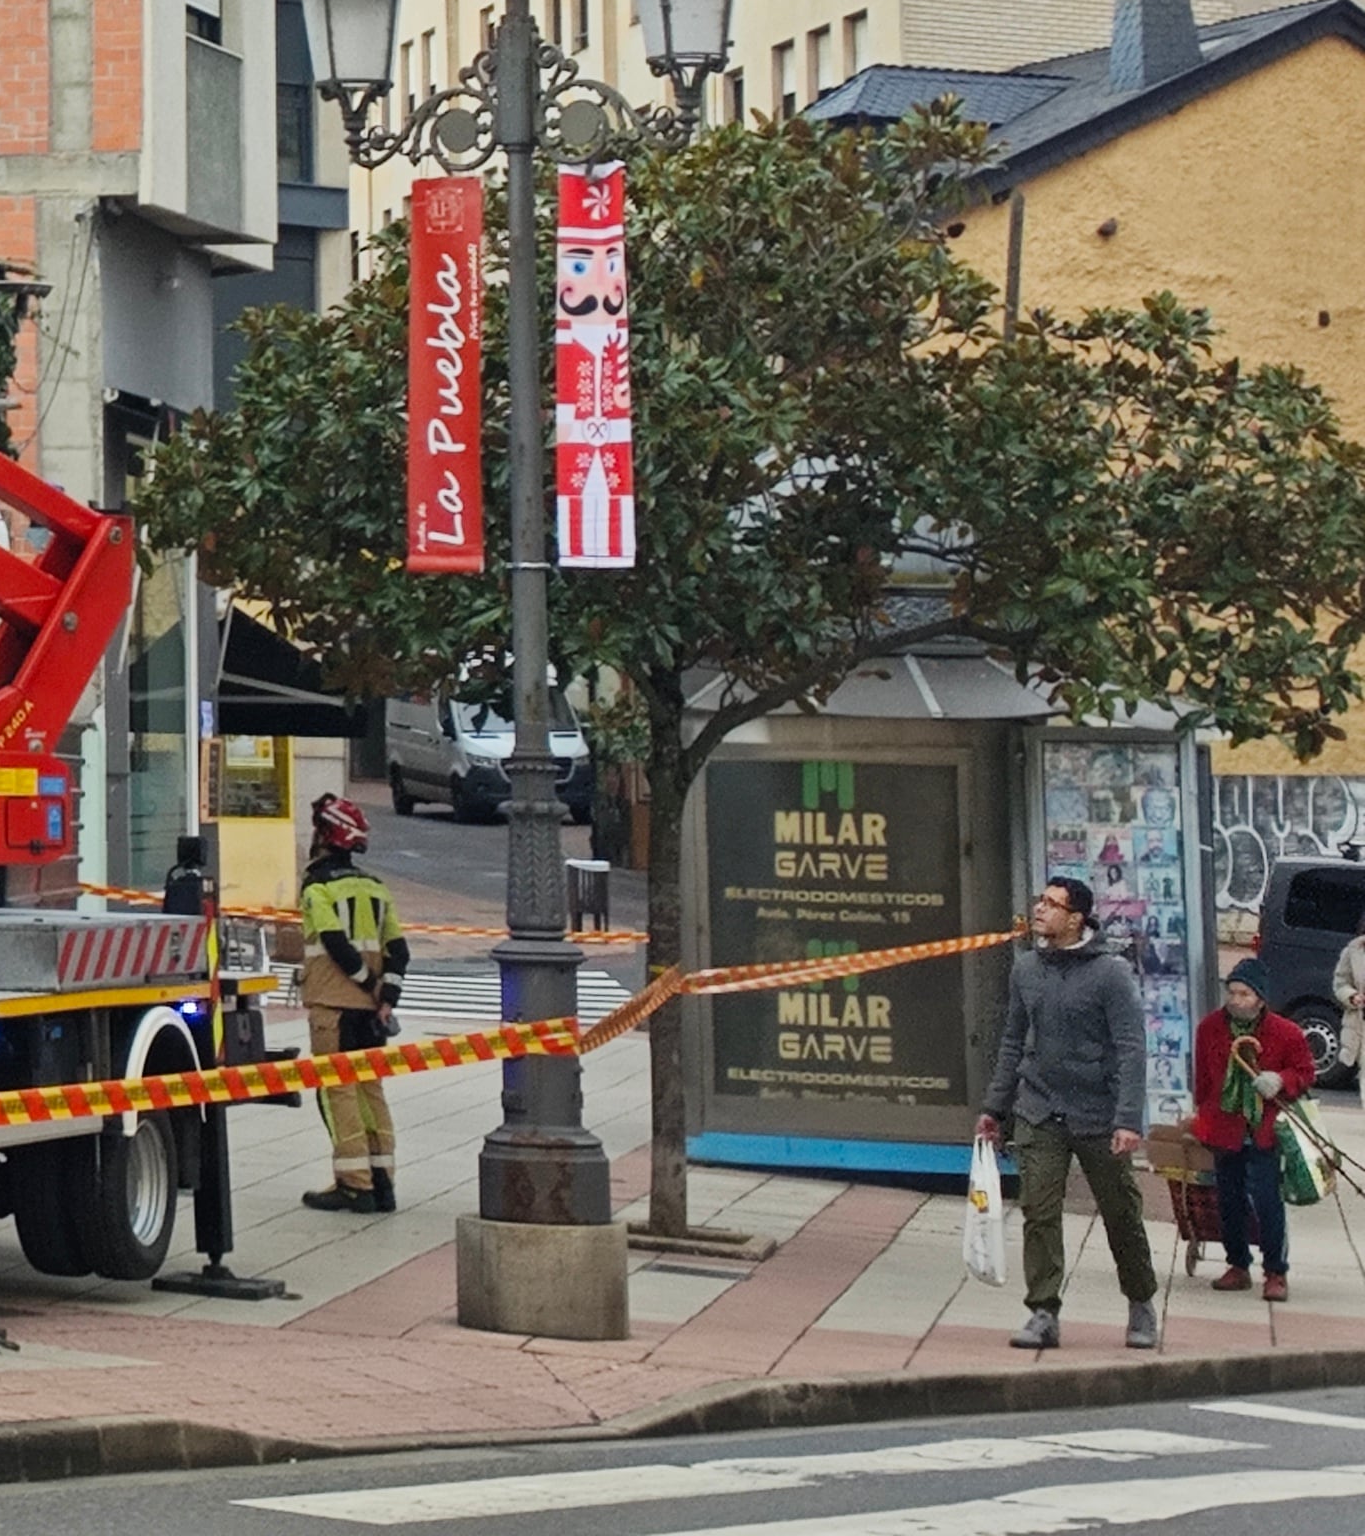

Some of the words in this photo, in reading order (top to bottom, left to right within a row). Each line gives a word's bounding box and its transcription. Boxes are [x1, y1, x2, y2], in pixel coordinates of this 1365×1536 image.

[425, 253, 467, 456] Puebla
[426, 469, 466, 547] La
[773, 810, 888, 847] MILAR
[774, 851, 889, 881] GARVE
[777, 992, 891, 1029] MILAR
[778, 1032, 893, 1064] GARVE
